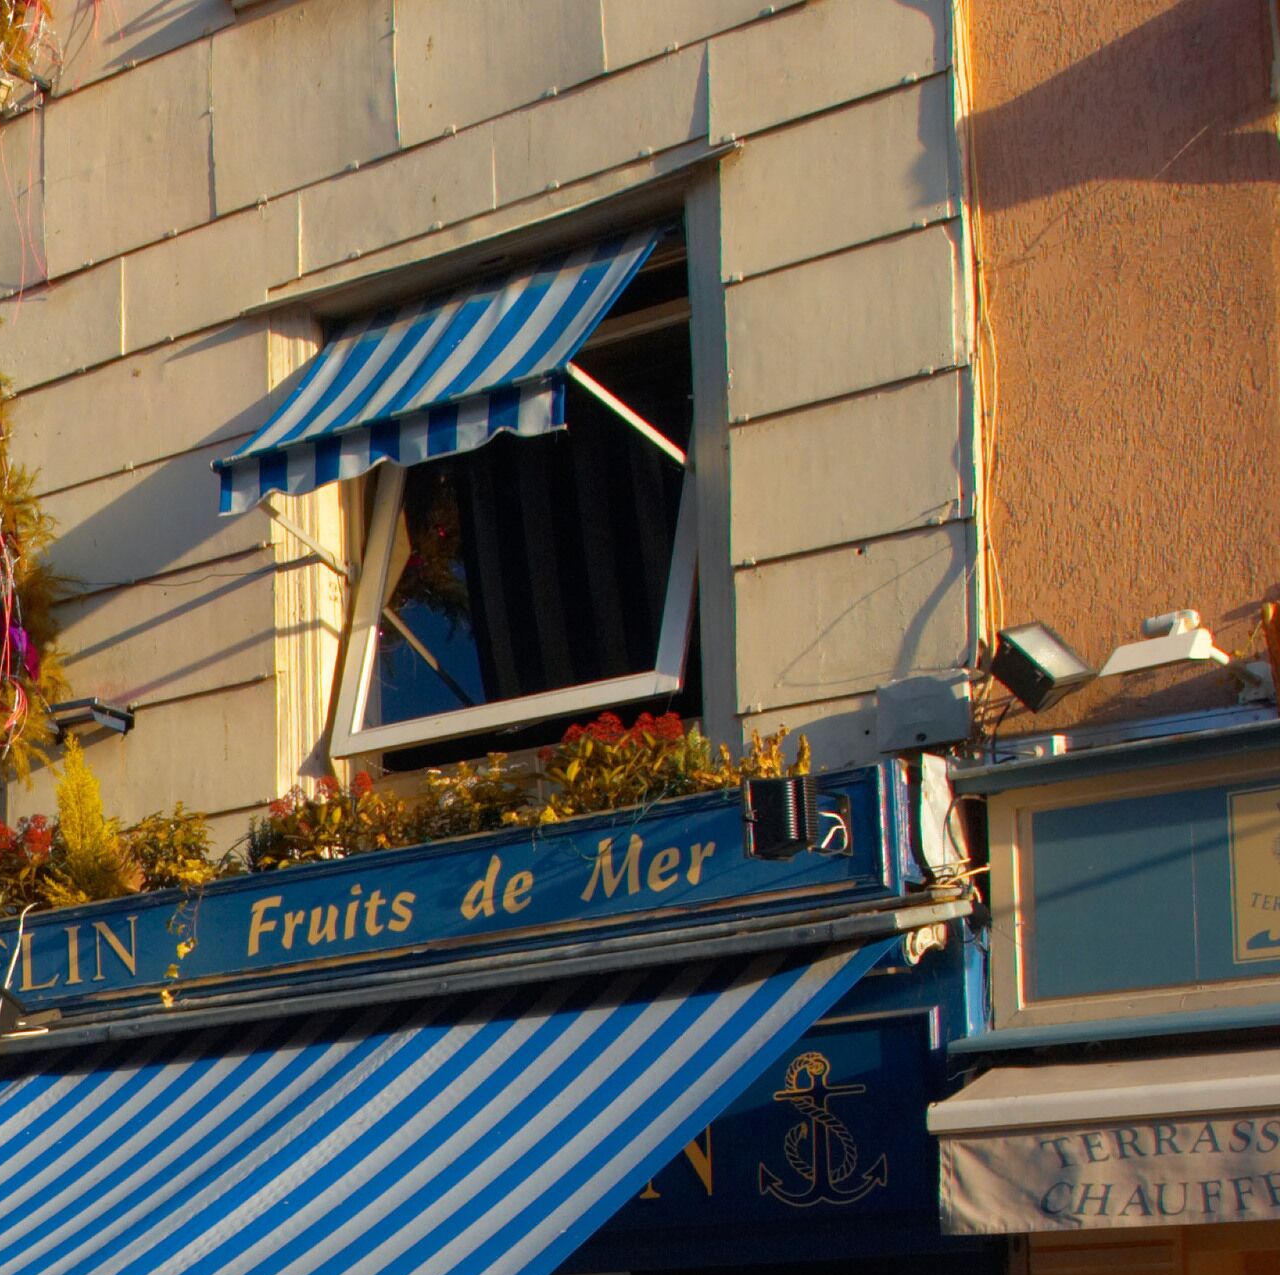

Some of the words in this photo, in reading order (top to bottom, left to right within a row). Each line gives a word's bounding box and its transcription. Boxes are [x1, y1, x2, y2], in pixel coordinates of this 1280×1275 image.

[247, 882, 417, 958] Fruits
[460, 853, 536, 921] de
[580, 832, 717, 904] Mer
[1040, 1118, 1280, 1169] TERRASS
